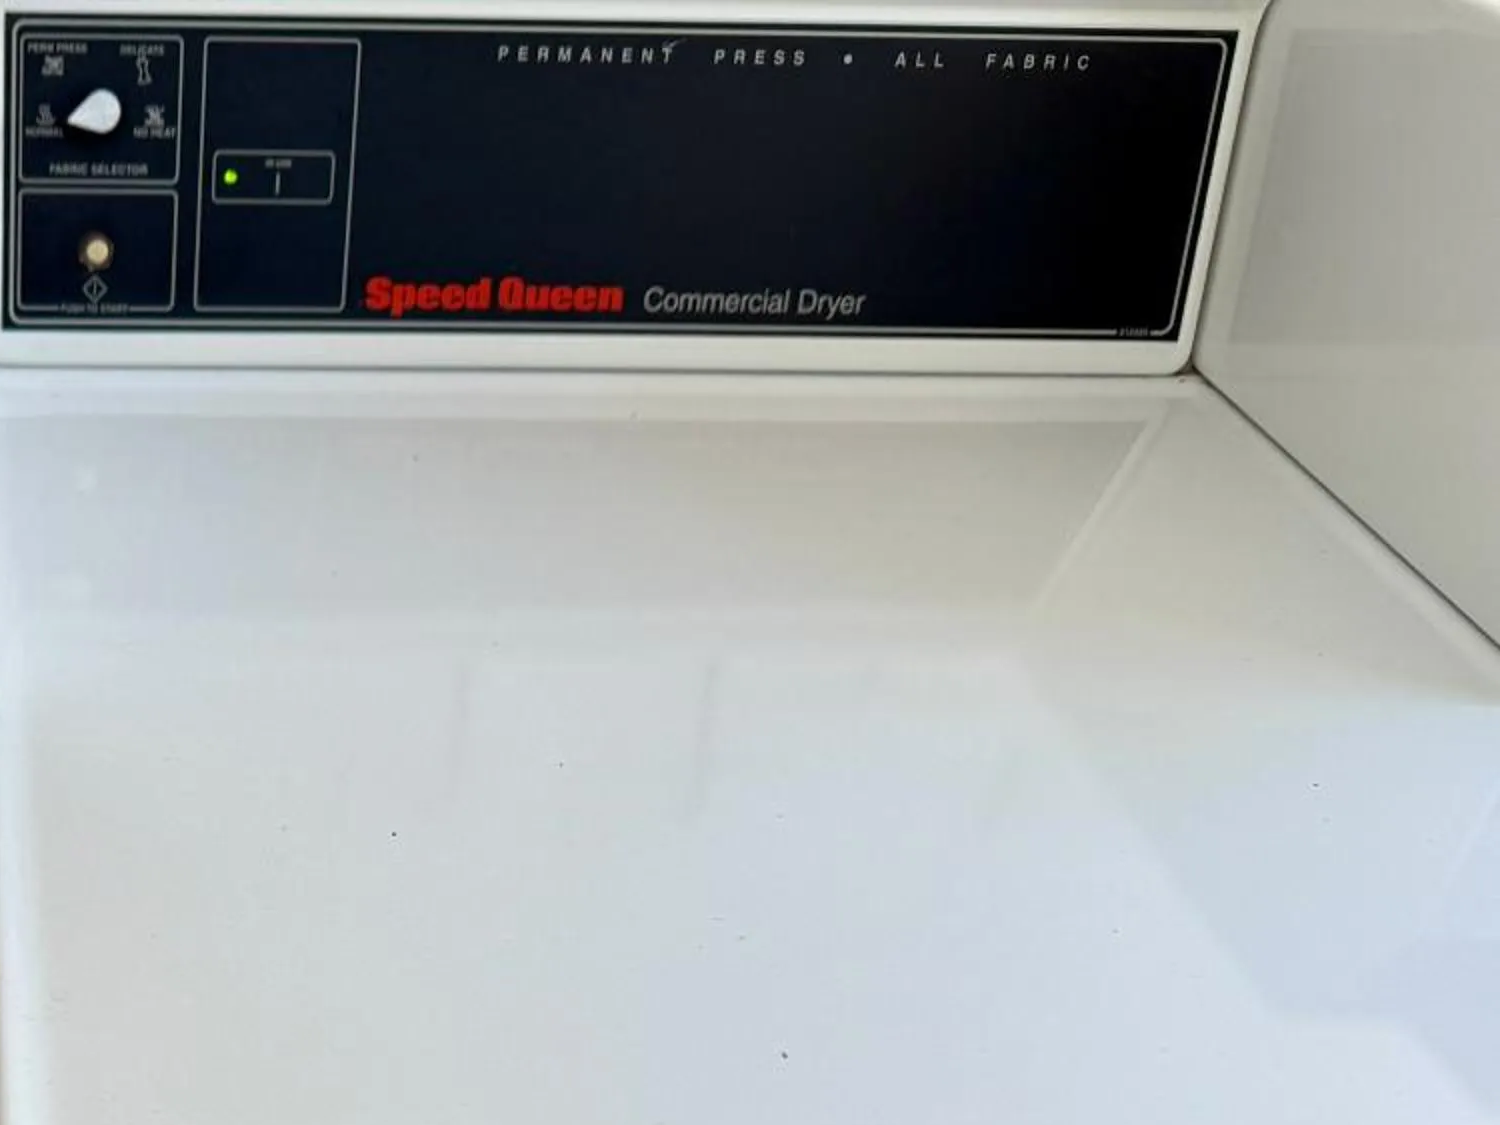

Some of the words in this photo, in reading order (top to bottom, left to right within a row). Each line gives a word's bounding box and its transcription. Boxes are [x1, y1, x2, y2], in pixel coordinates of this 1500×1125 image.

[27, 42, 54, 54] PERM
[56, 42, 88, 54] PRESS
[119, 44, 165, 56] DELICATE
[497, 45, 676, 64] PERMANENT
[713, 48, 806, 66] PRESS
[894, 52, 946, 68] ALL
[985, 53, 1092, 71] FABRIC
[25, 127, 63, 138] NORMAL
[150, 127, 177, 139] HEAT
[49, 163, 88, 176] FABRIC
[91, 163, 148, 176] SELECTOR
[364, 277, 492, 318] Speed
[497, 277, 625, 312] Queen
[643, 285, 791, 315] Commercial
[796, 289, 867, 320] Dryer
